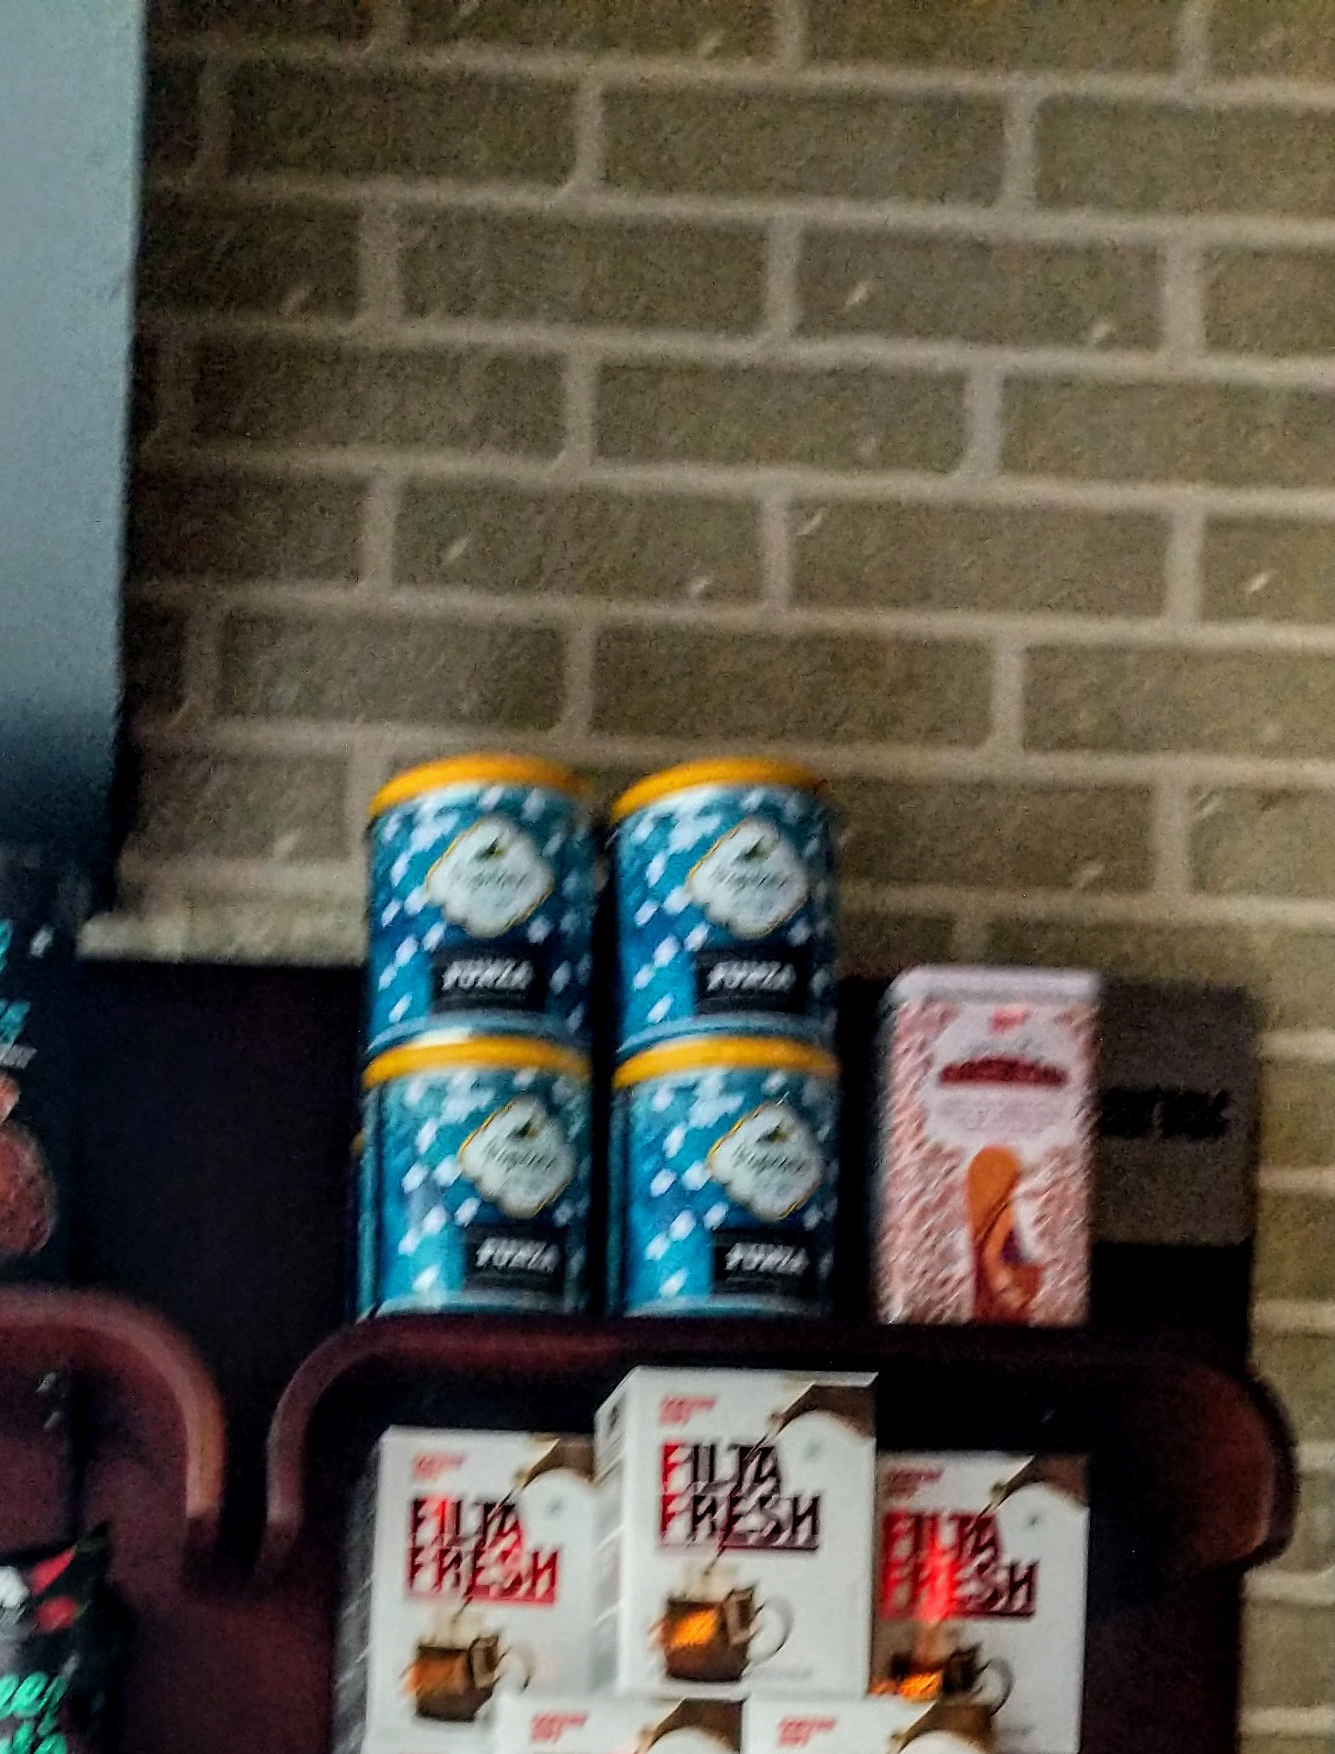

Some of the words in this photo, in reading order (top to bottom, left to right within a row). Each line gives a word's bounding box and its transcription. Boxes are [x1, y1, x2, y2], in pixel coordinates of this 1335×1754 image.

[660, 1442, 782, 1494] FILTA
[409, 1497, 524, 1547] FILTA
[659, 1493, 821, 1550] FRESH
[407, 1546, 561, 1601] FRESH
[879, 1560, 1039, 1619] FRESH
